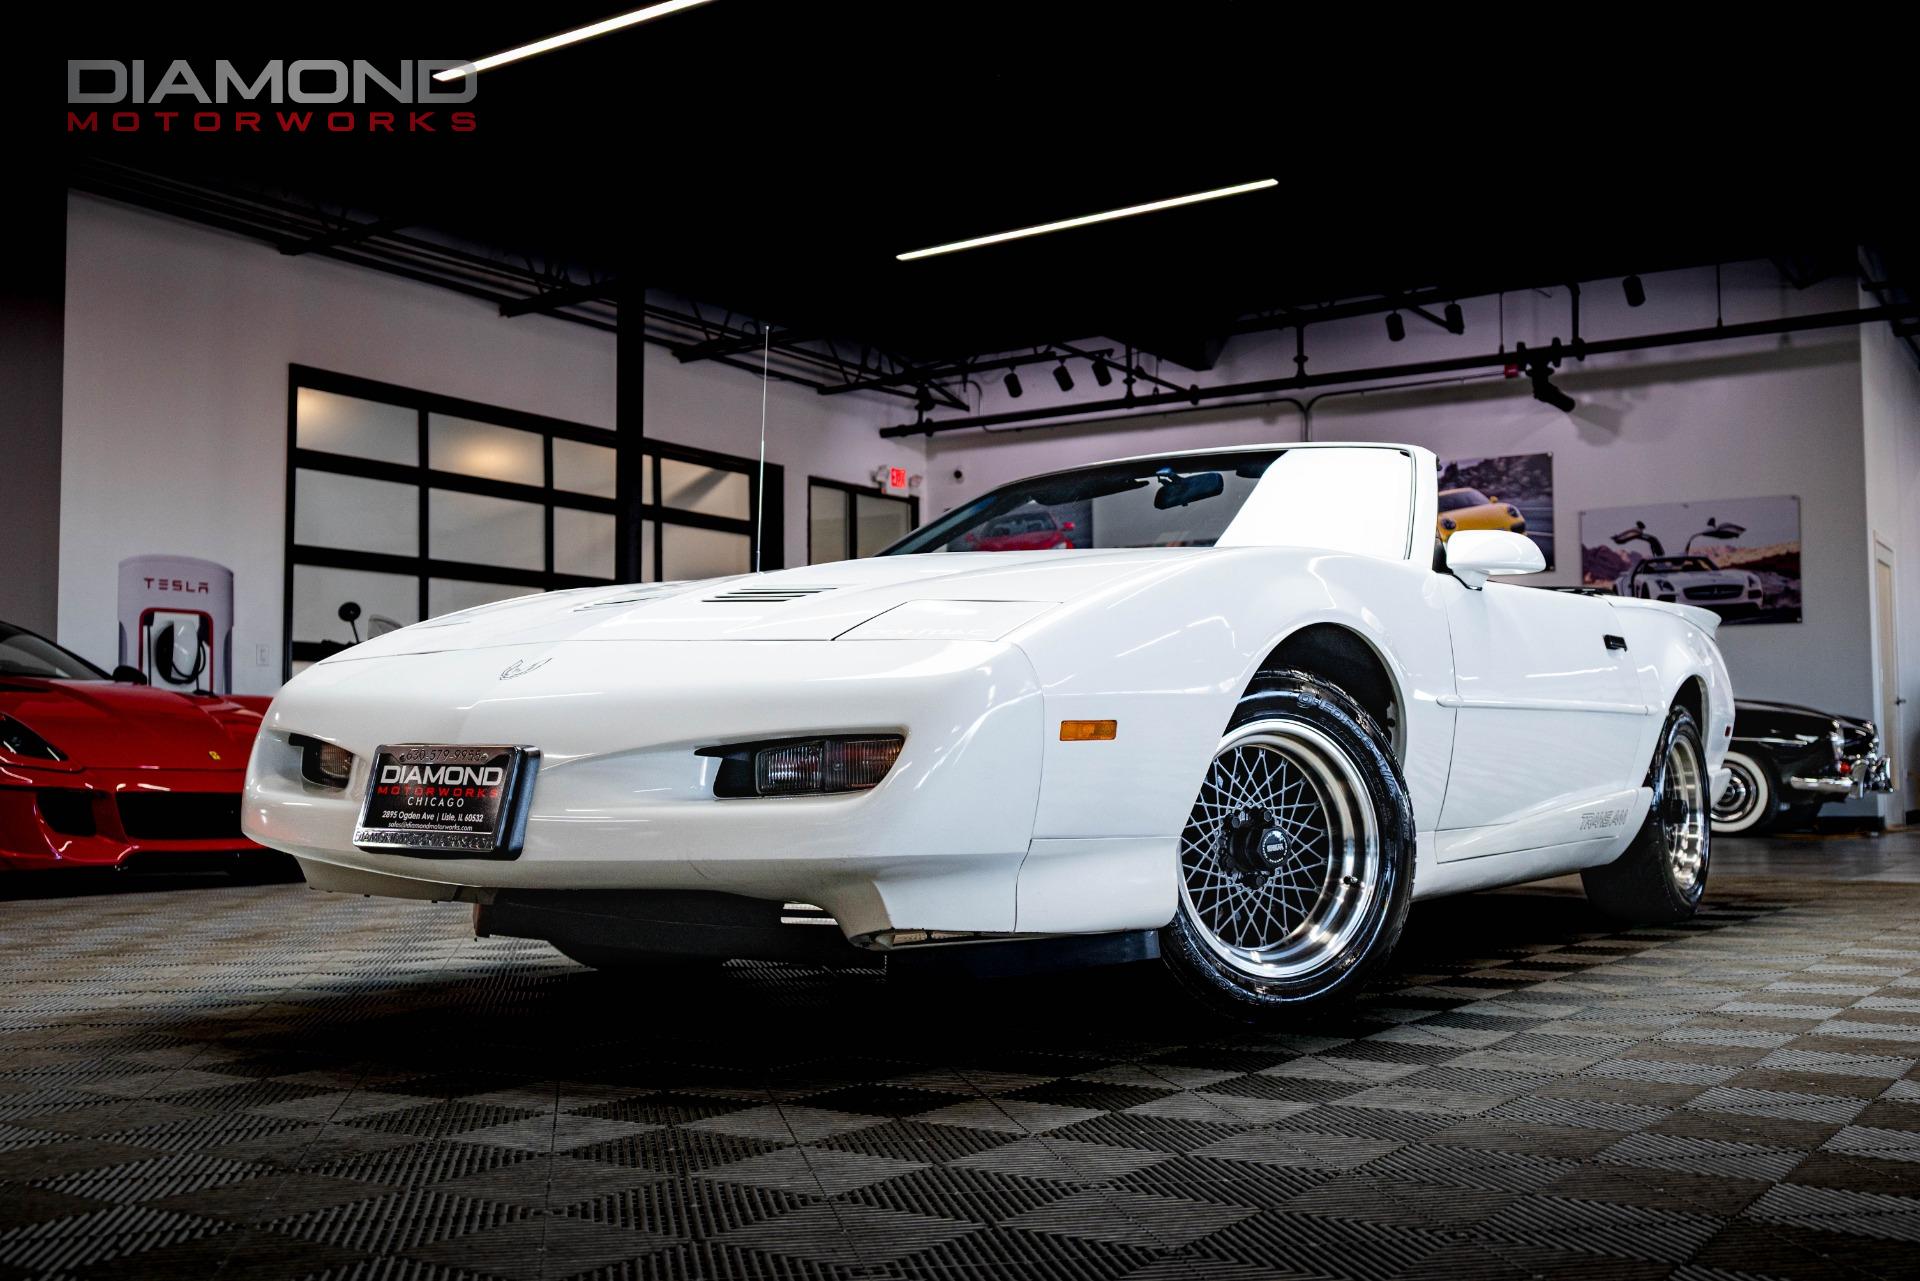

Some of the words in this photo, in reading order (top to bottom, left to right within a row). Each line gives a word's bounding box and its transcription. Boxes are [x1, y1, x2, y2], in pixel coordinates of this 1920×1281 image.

[144, 577, 208, 593] TESLA
[381, 765, 502, 785] DIAMOND
[377, 786, 499, 797] MOTORWORKS
[407, 796, 465, 808] CHICAGO
[382, 810, 397, 819] 2895
[398, 811, 420, 821] Ogden
[421, 812, 435, 821] Ave
[464, 814, 484, 823] 60532
